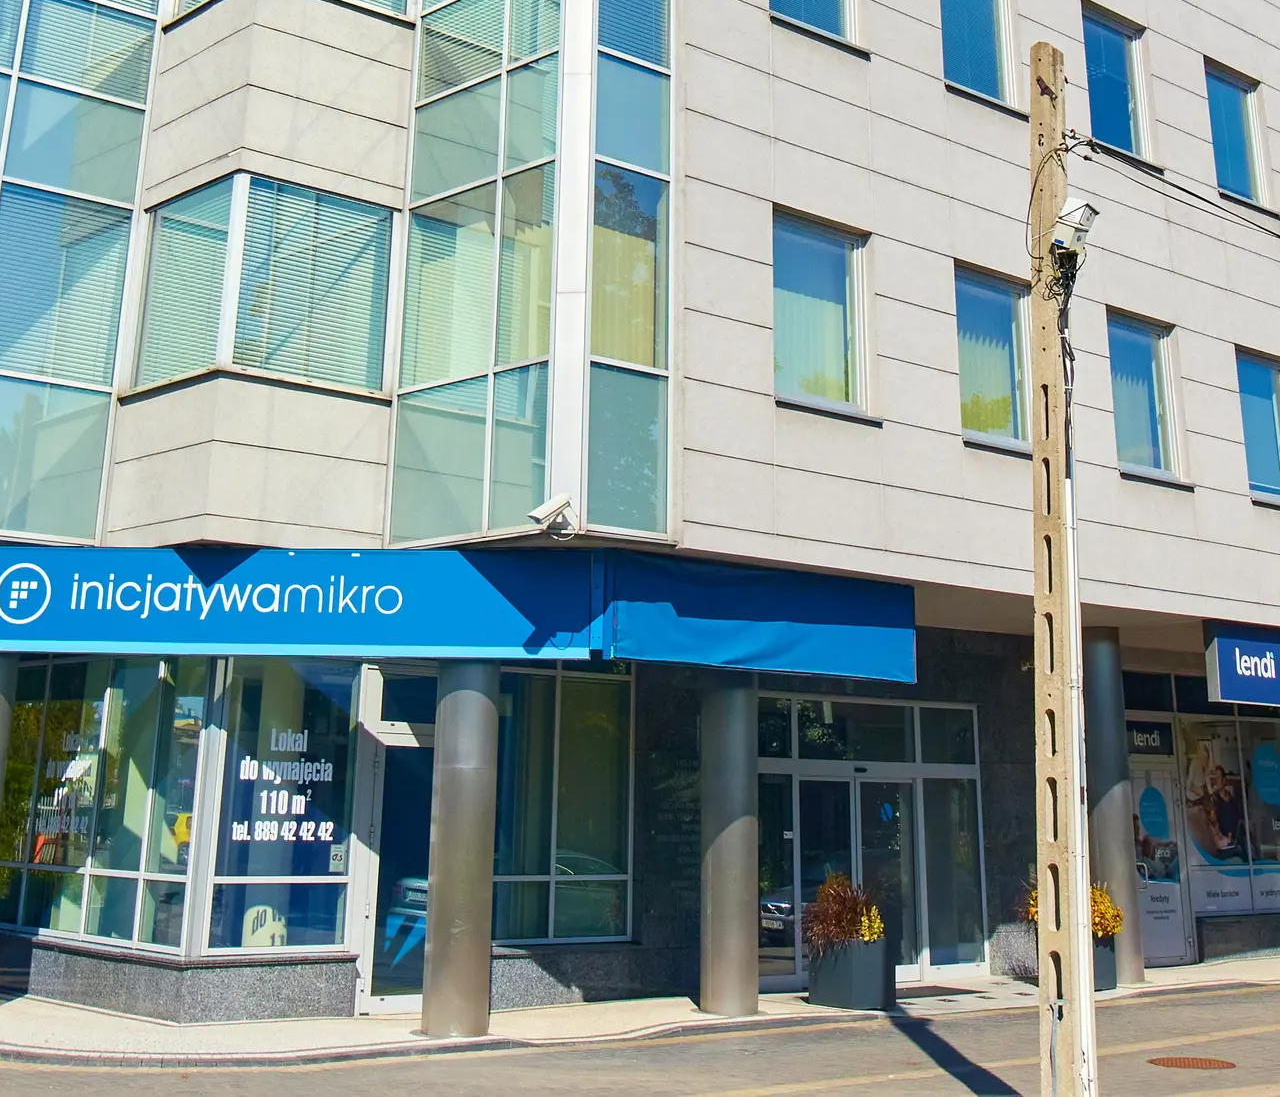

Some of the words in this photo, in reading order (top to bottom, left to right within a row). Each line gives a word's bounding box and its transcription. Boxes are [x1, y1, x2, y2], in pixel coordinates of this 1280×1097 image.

[70, 572, 404, 621] inicjatywamikro
[1234, 647, 1276, 678] lendi
[271, 728, 308, 753] Lokal
[1133, 729, 1161, 746] lendi
[240, 756, 258, 781] do
[263, 758, 334, 785] wynajęcia
[260, 789, 288, 815] 110
[232, 821, 251, 841] tel.
[254, 821, 279, 841] 889
[280, 821, 297, 841] 42
[299, 821, 315, 841] 42
[317, 821, 334, 841] 42
